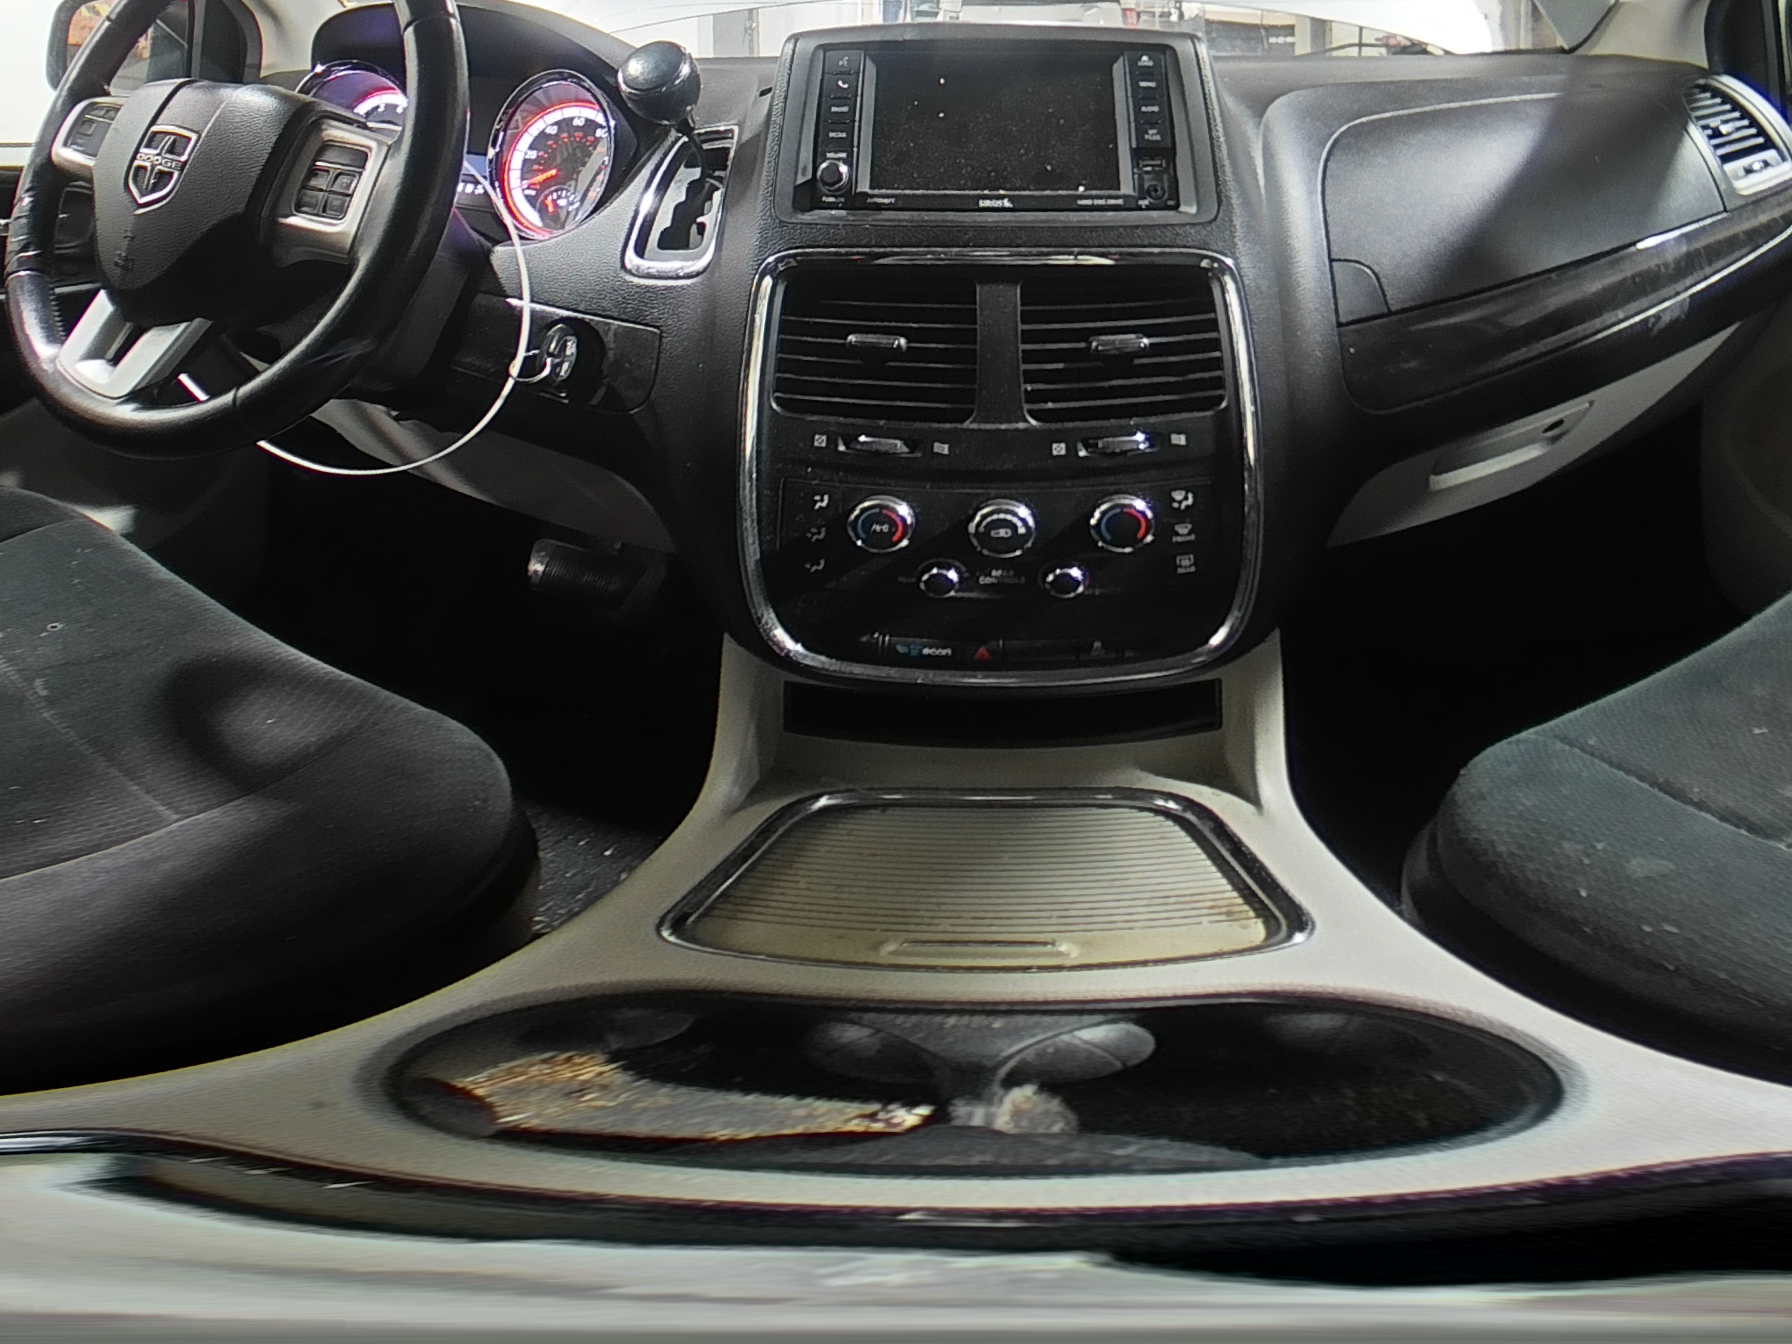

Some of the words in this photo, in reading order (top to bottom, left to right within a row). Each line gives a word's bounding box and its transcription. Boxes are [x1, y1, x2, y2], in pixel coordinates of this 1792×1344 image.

[572, 117, 586, 127] 60
[544, 125, 559, 135] 40
[524, 149, 538, 159] 20
[137, 152, 181, 169] DODGE
